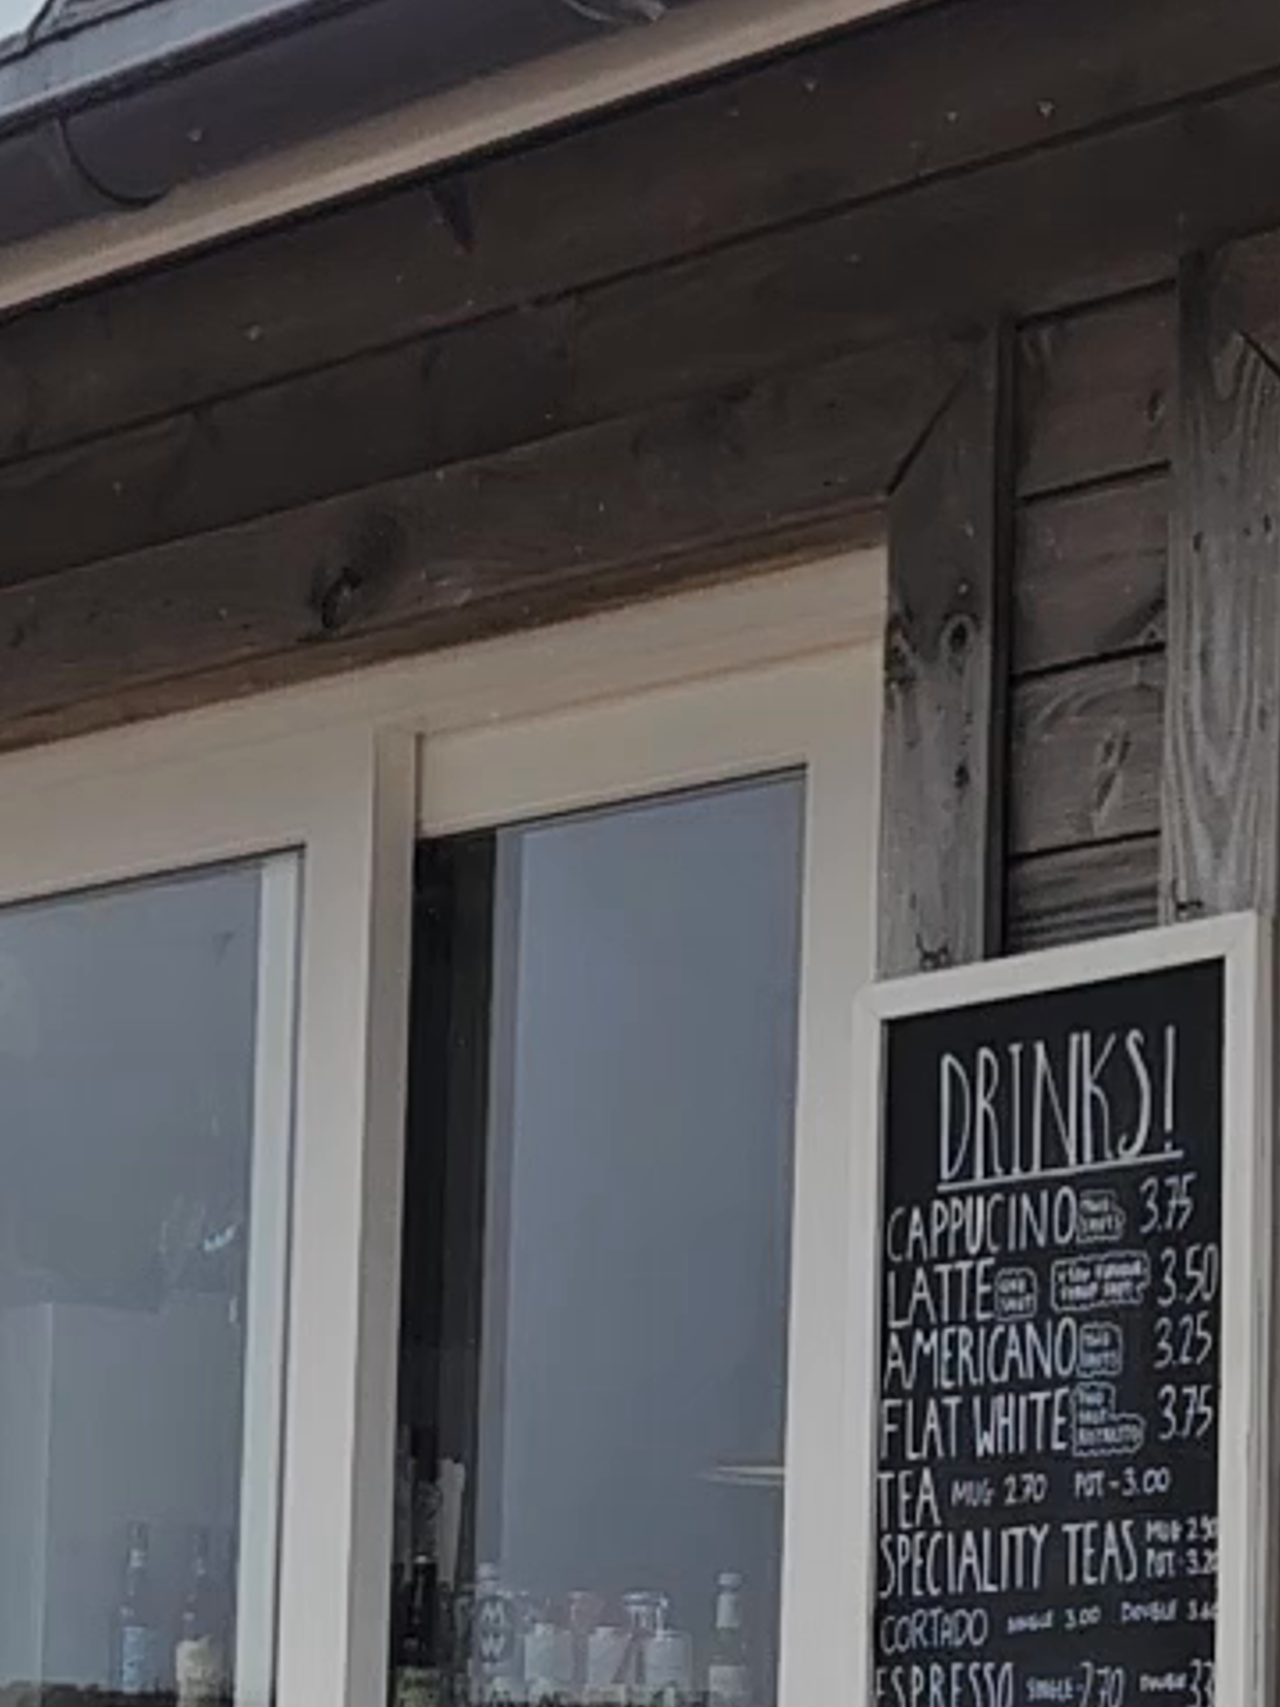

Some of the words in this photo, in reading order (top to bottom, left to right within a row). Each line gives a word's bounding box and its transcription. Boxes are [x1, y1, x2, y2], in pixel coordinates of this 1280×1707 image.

[939, 1026, 1176, 1182] DRINKS!
[886, 1186, 1078, 1263] CAPPUCINO
[1140, 1172, 1197, 1234] 3.75
[887, 1257, 997, 1329] LATTE
[1158, 1244, 1219, 1307] 3.50
[883, 1317, 1078, 1390] AMERICANO
[1153, 1311, 1214, 1369] 3.25
[880, 1396, 964, 1461] FLAT
[972, 1387, 1071, 1458] WHITE
[1158, 1385, 1213, 1440] 3.75
[877, 1467, 941, 1532] TEA
[1074, 1470, 1107, 1499] POT
[878, 1523, 1050, 1599] SPECIALITY
[1062, 1519, 1139, 1586] TEAS
[879, 1606, 990, 1654] CORTADO
